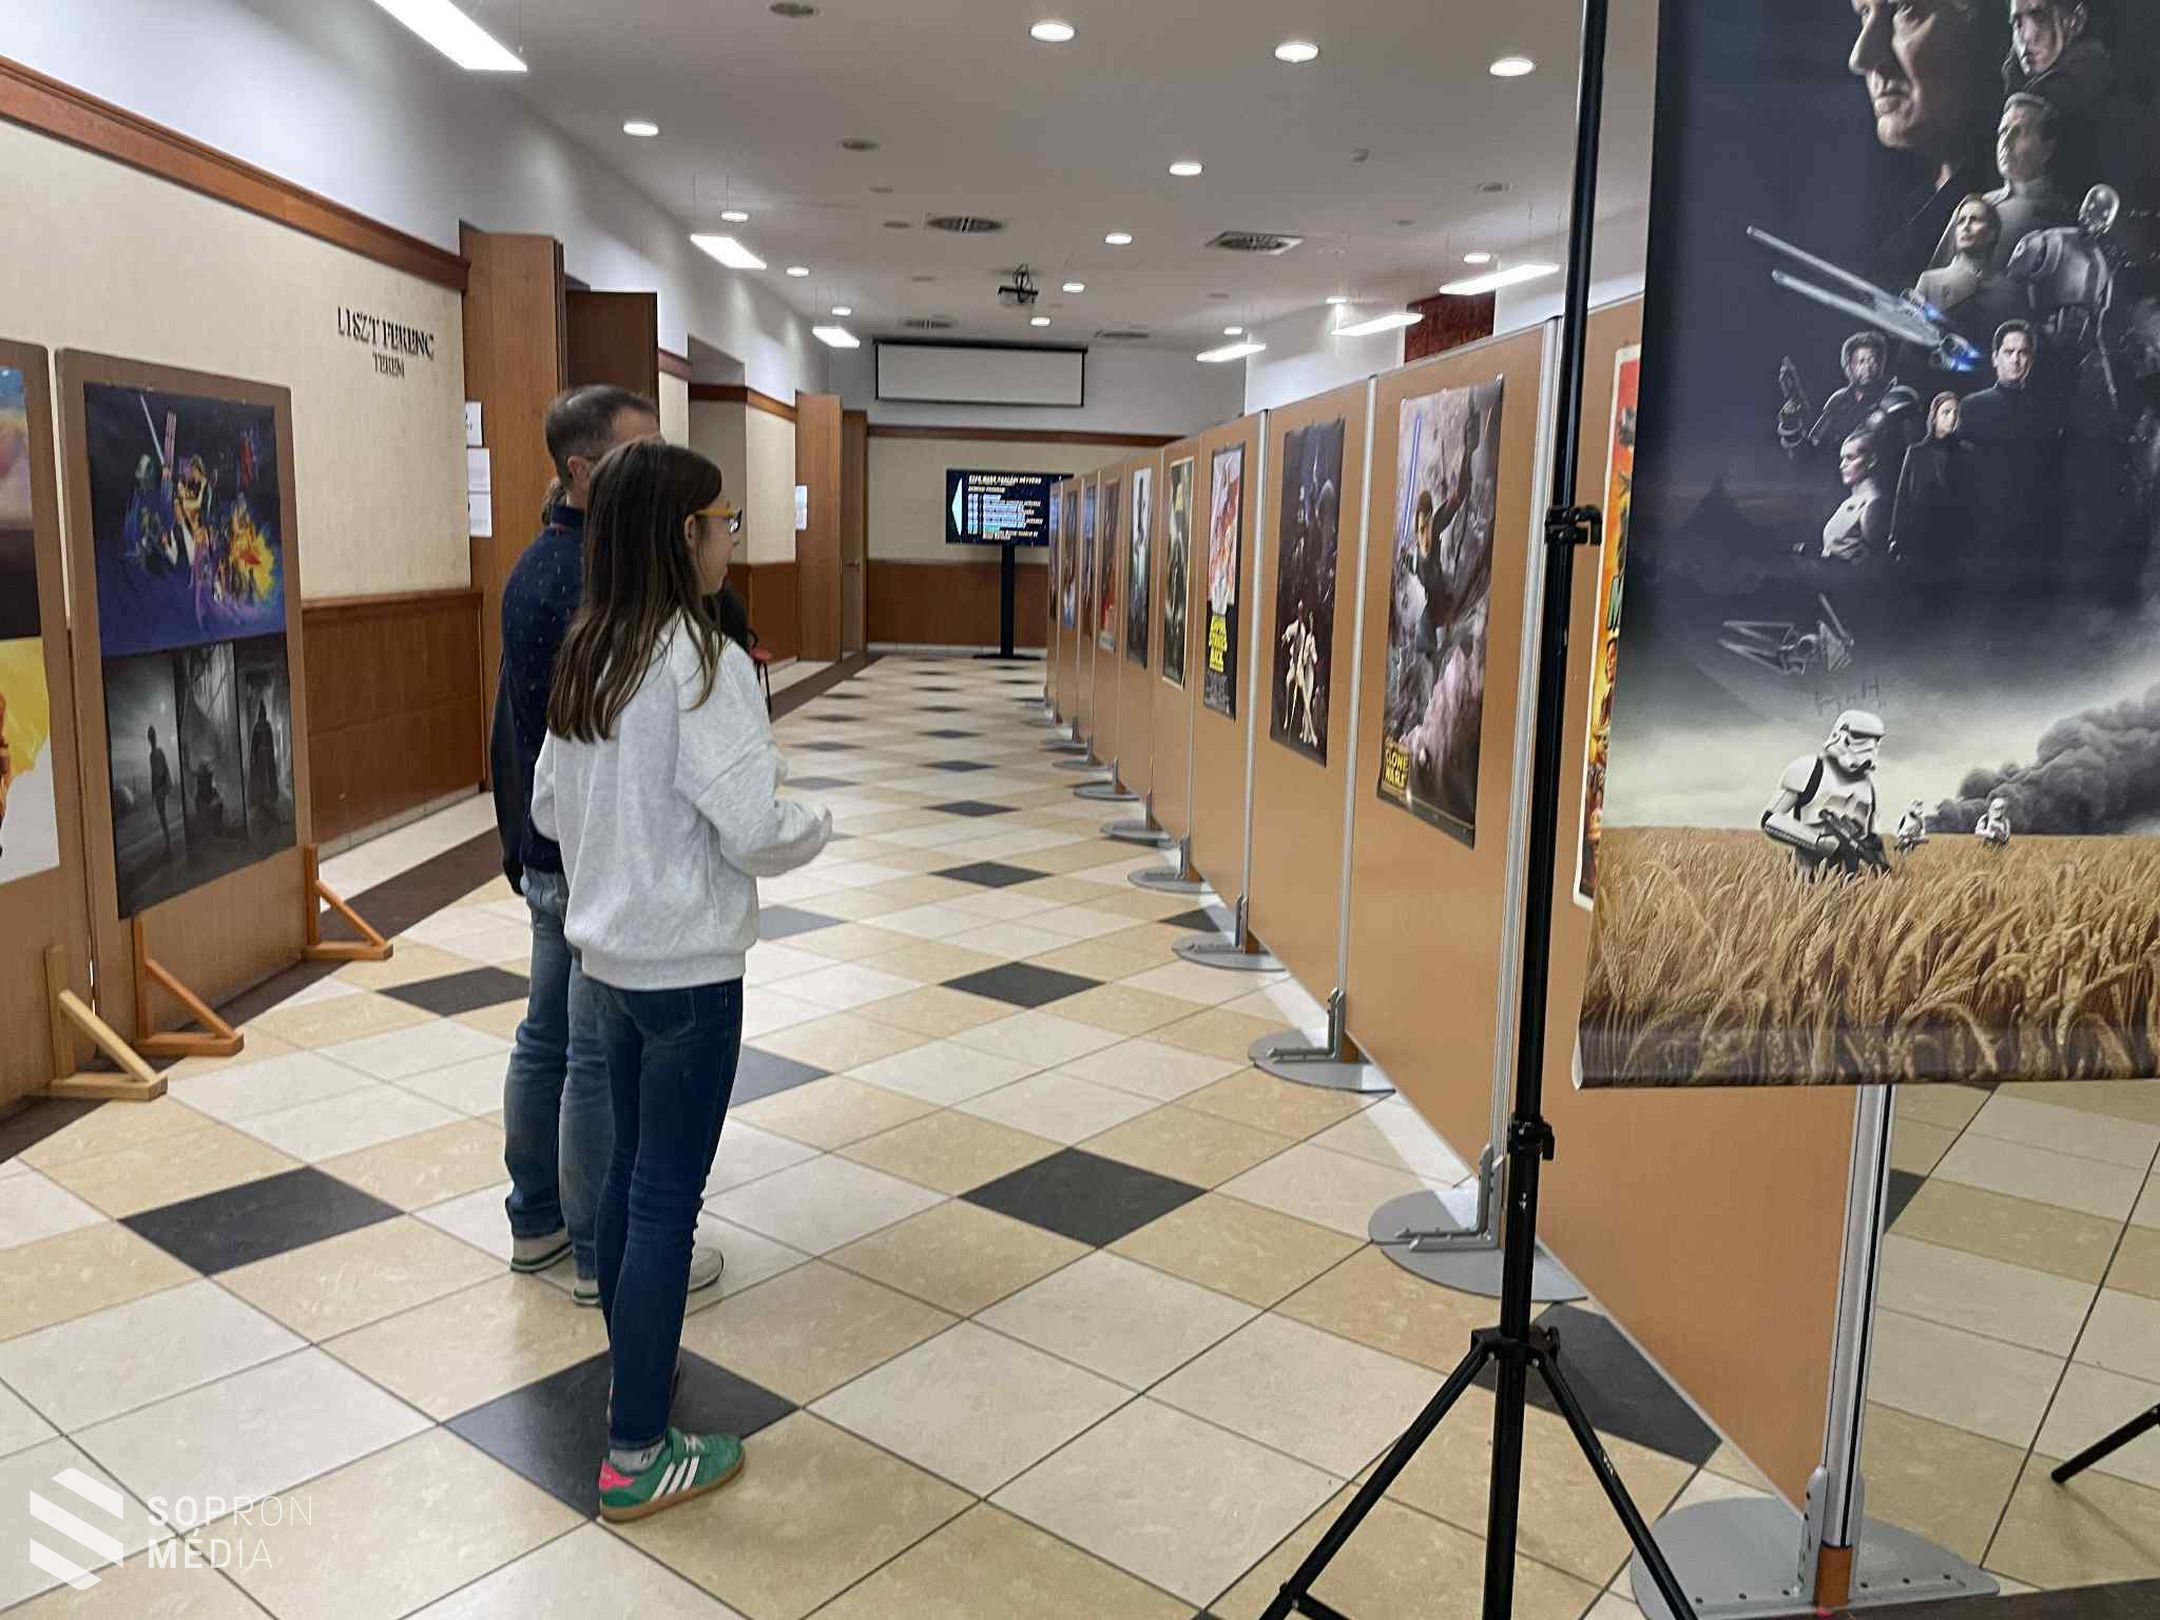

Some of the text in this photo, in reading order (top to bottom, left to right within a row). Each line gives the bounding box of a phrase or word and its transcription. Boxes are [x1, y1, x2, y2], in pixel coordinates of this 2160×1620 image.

[338, 306, 434, 361] LISZT FERENC
[372, 352, 405, 379] TEREM
